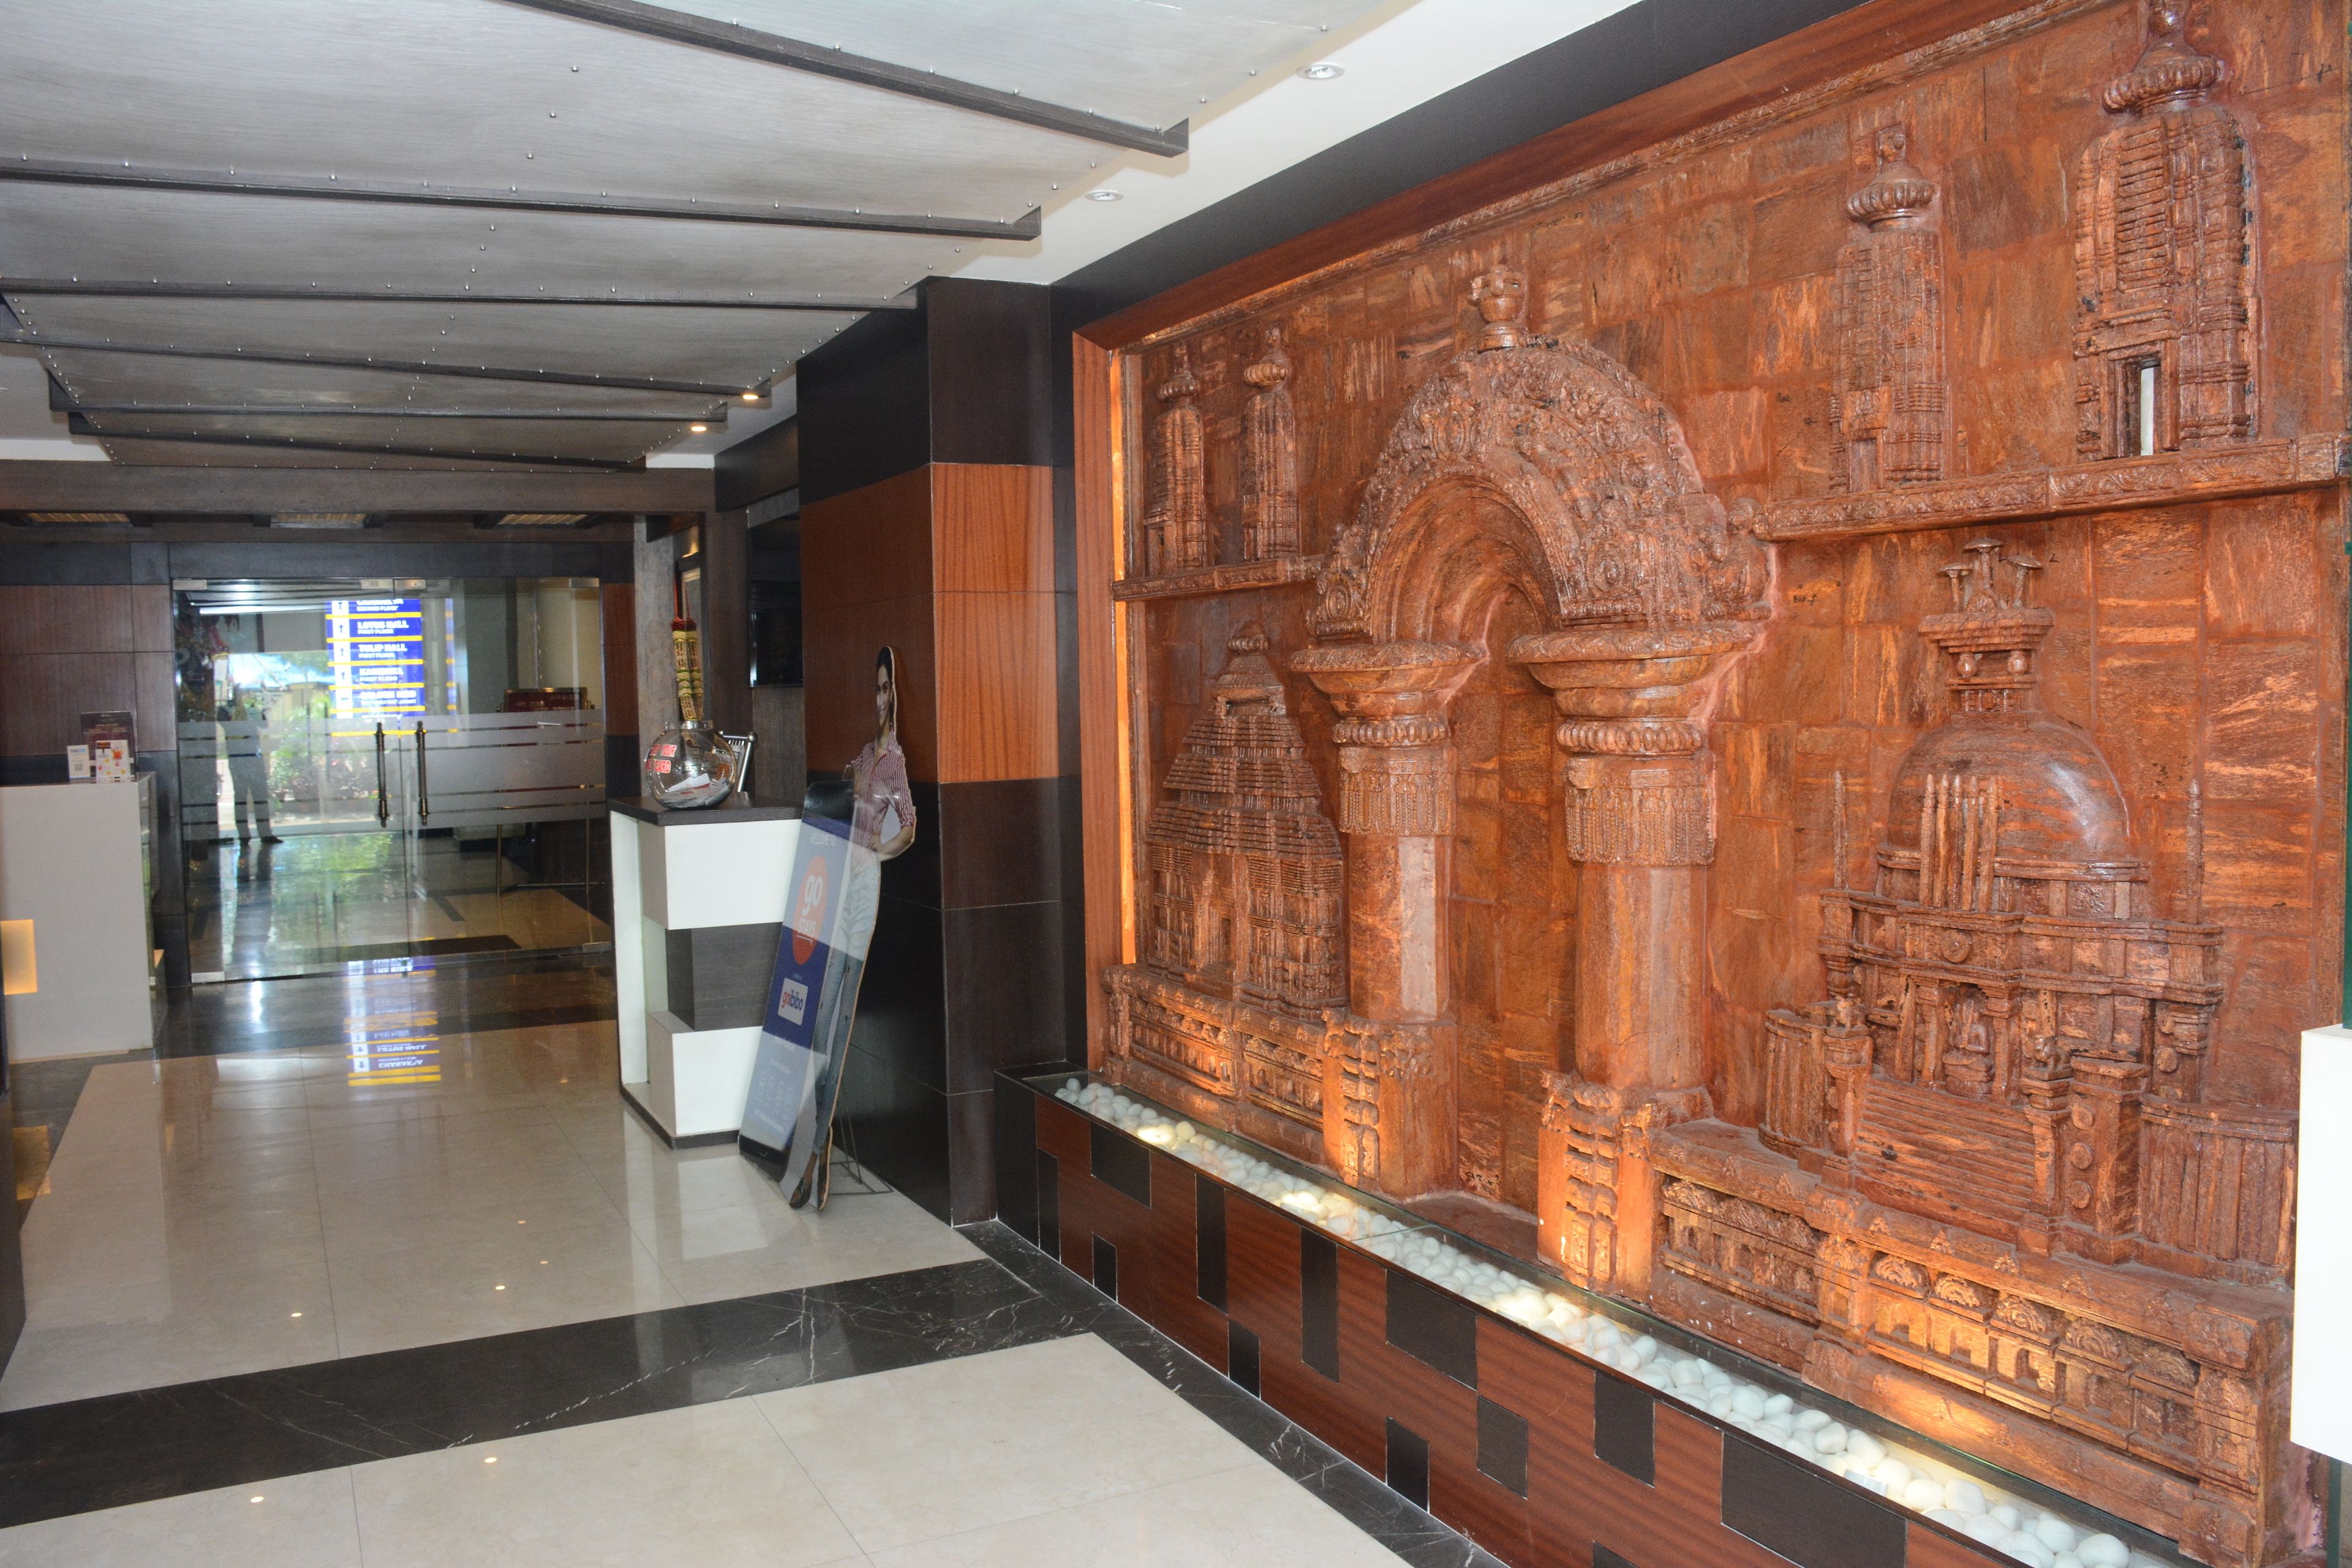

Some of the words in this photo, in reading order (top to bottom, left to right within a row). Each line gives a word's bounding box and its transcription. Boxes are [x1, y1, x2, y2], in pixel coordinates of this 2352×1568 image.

[654, 760, 671, 773] CARD
[801, 874, 823, 916] go
[782, 989, 804, 1011] goibibo
